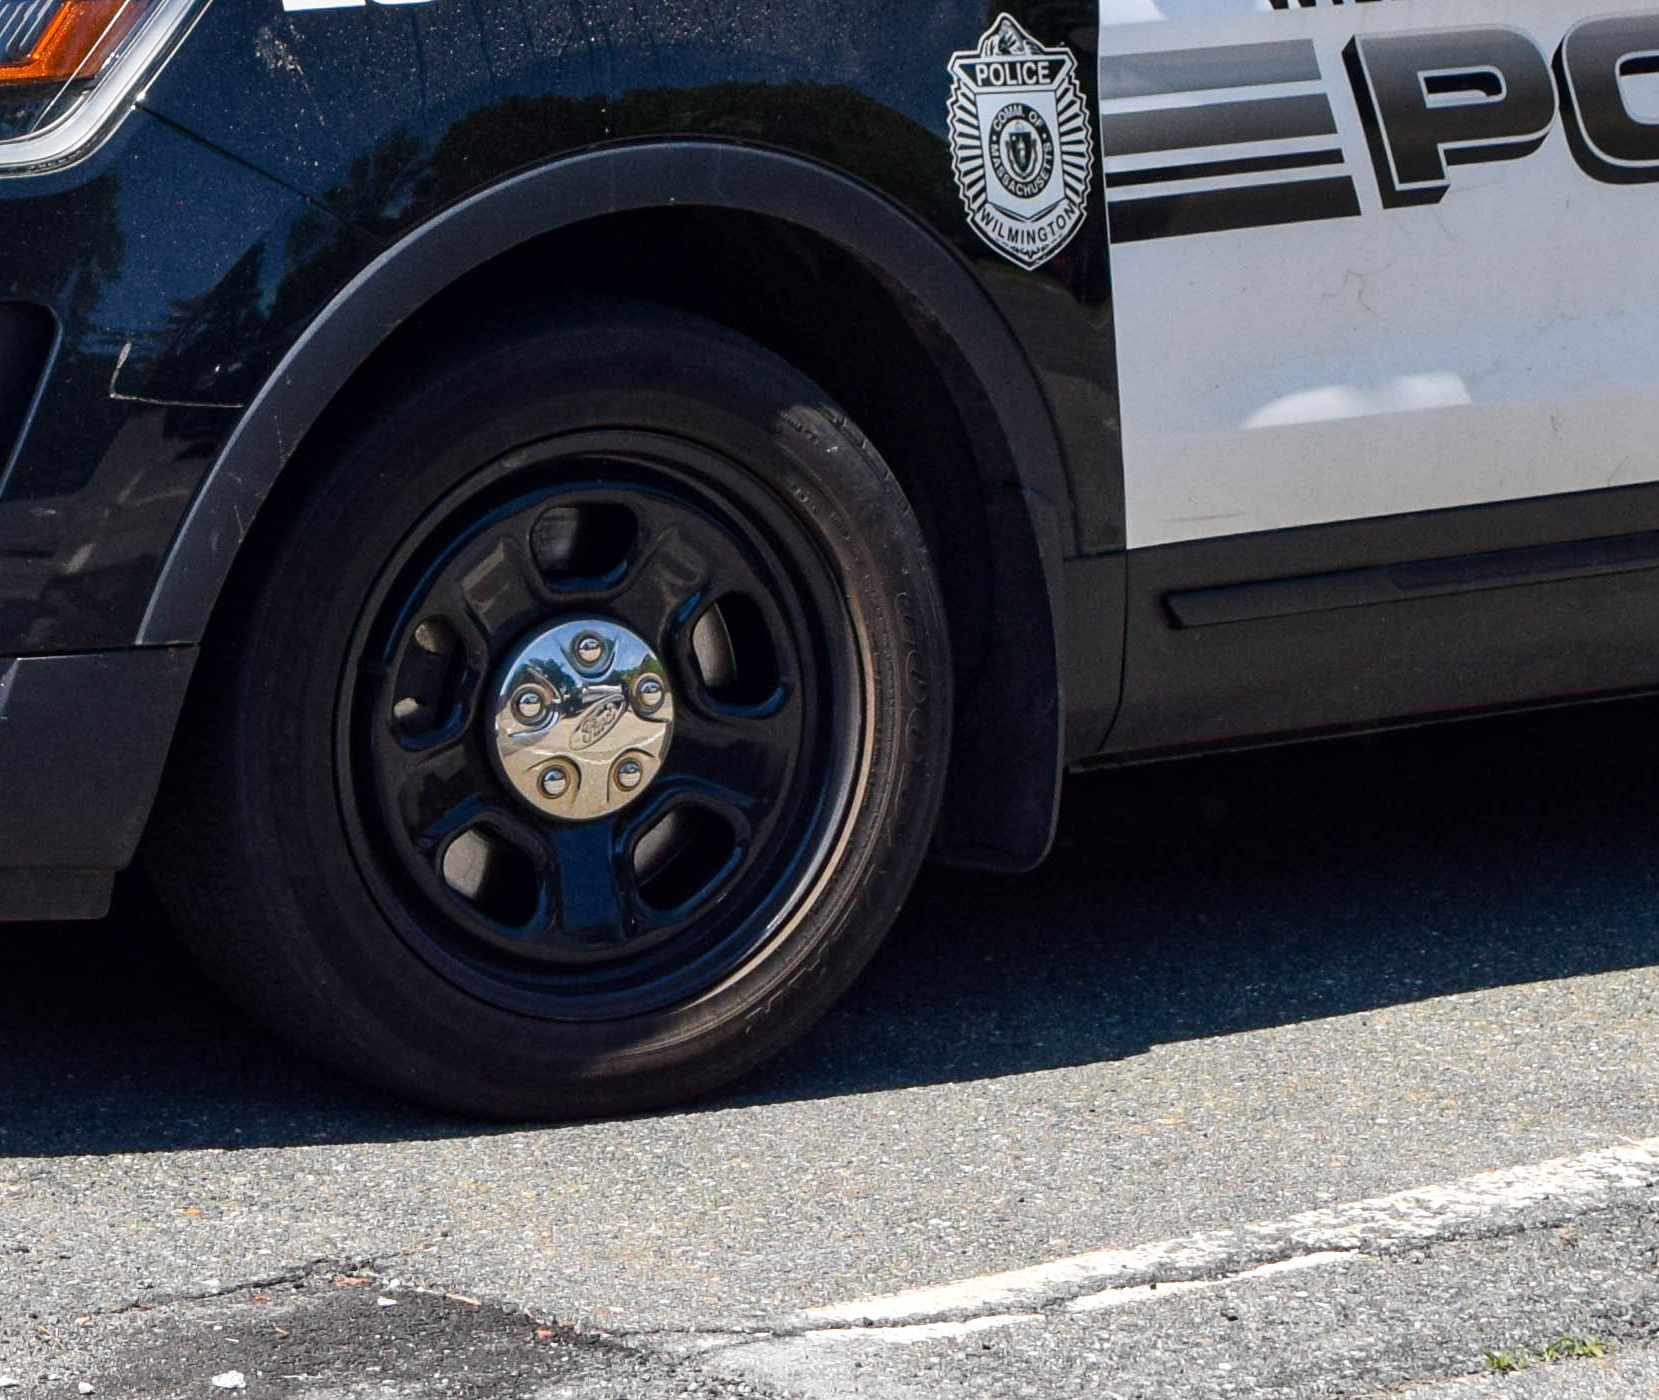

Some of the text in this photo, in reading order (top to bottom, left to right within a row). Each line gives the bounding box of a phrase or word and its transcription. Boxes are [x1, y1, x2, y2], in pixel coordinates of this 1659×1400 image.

[975, 61, 1052, 87] POLICE
[1028, 111, 1045, 130] OF
[989, 143, 1054, 198] MASSACHUSETTS
[978, 203, 1077, 244] WILMINGTON
